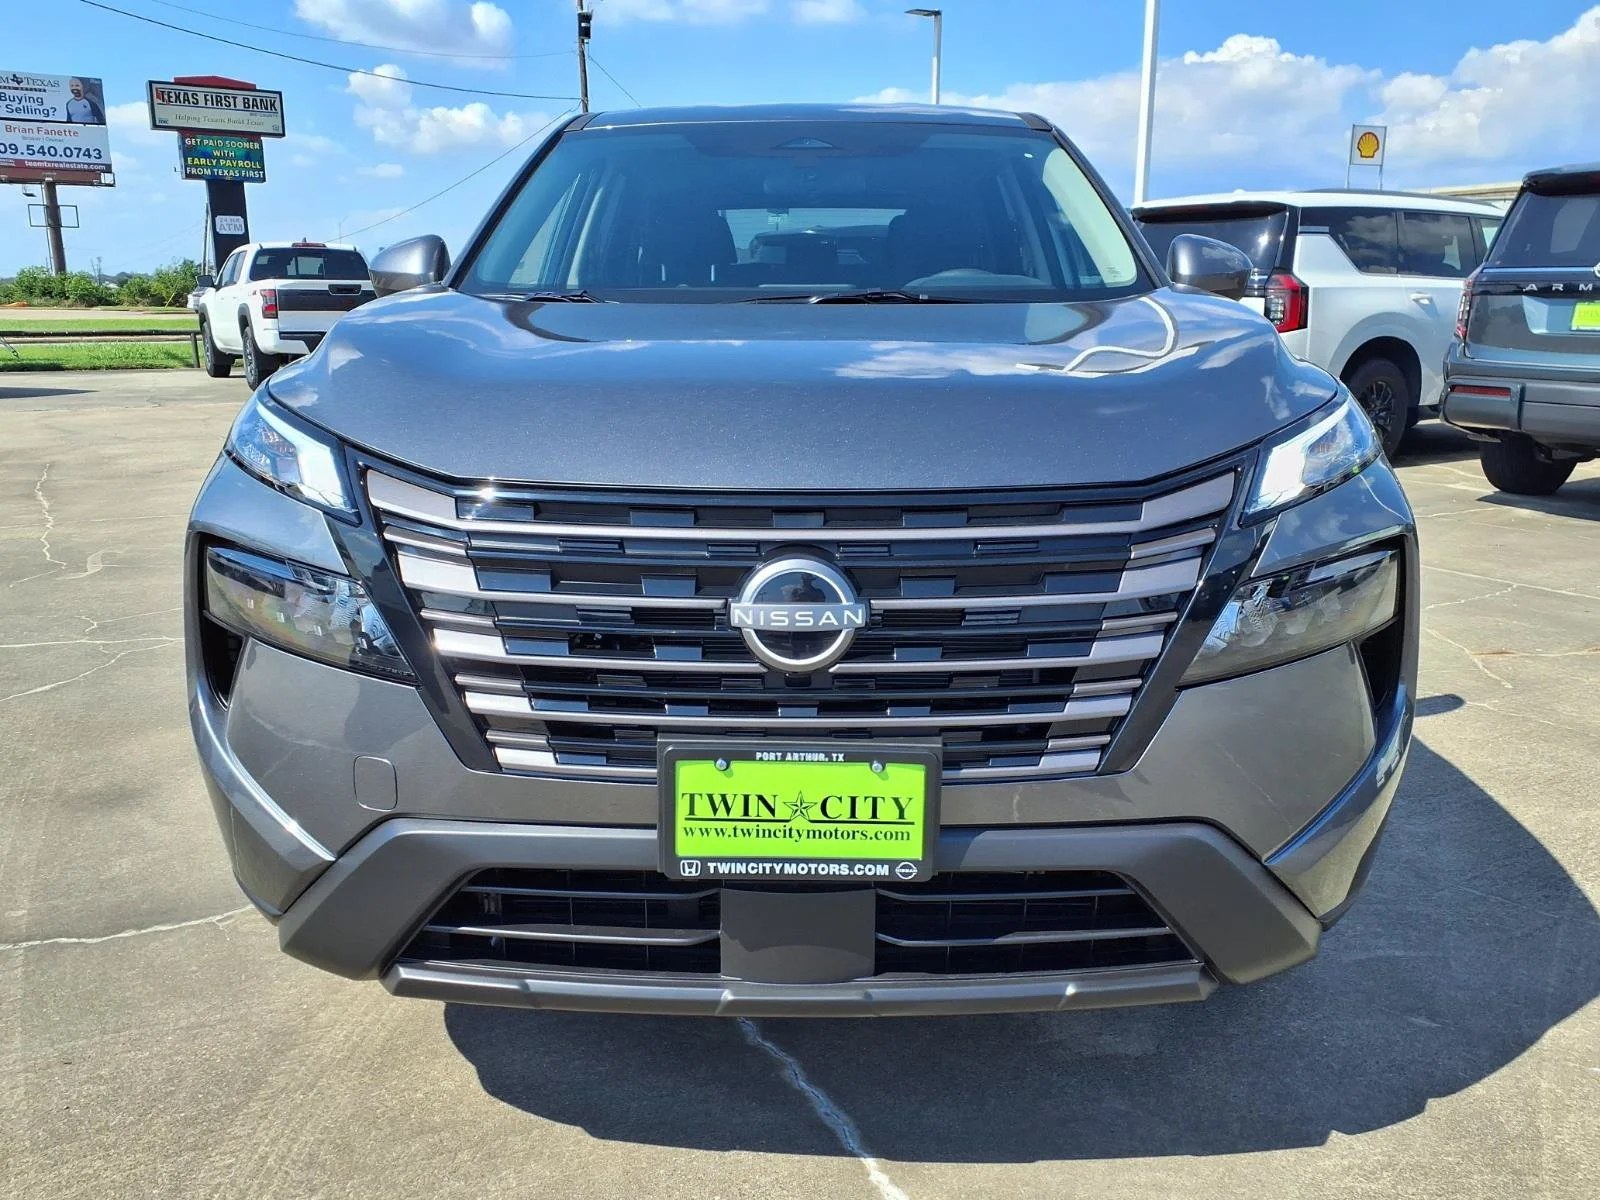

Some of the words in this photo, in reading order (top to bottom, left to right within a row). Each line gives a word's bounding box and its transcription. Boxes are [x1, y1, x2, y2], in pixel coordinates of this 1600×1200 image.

[24, 76, 60, 88] TEXAS
[0, 92, 44, 106] Buying
[160, 90, 199, 106] TEXAS
[204, 93, 238, 108] FIRST
[243, 97, 278, 111] BANK
[5, 104, 57, 118] Selling?
[5, 125, 34, 135] Brian
[37, 127, 79, 138] Fanette
[185, 138, 200, 146] GET
[203, 139, 223, 147] PAID
[226, 141, 260, 150] SOONER
[213, 149, 235, 158] WITH
[187, 157, 219, 167] EARLY
[220, 159, 261, 169] PAYROLL
[186, 167, 212, 175] FROM
[213, 168, 239, 177] TEXAS
[241, 170, 264, 178] FIRST
[218, 223, 243, 232] ATM
[734, 608, 863, 626] NISSAN
[755, 751, 782, 761] PORT
[832, 753, 844, 762] TX
[681, 792, 779, 818] TWIN
[820, 795, 914, 820] CITY
[683, 824, 911, 843] www.twincitymotors.com
[707, 861, 890, 876] TWINCITYMOTORS.COM
